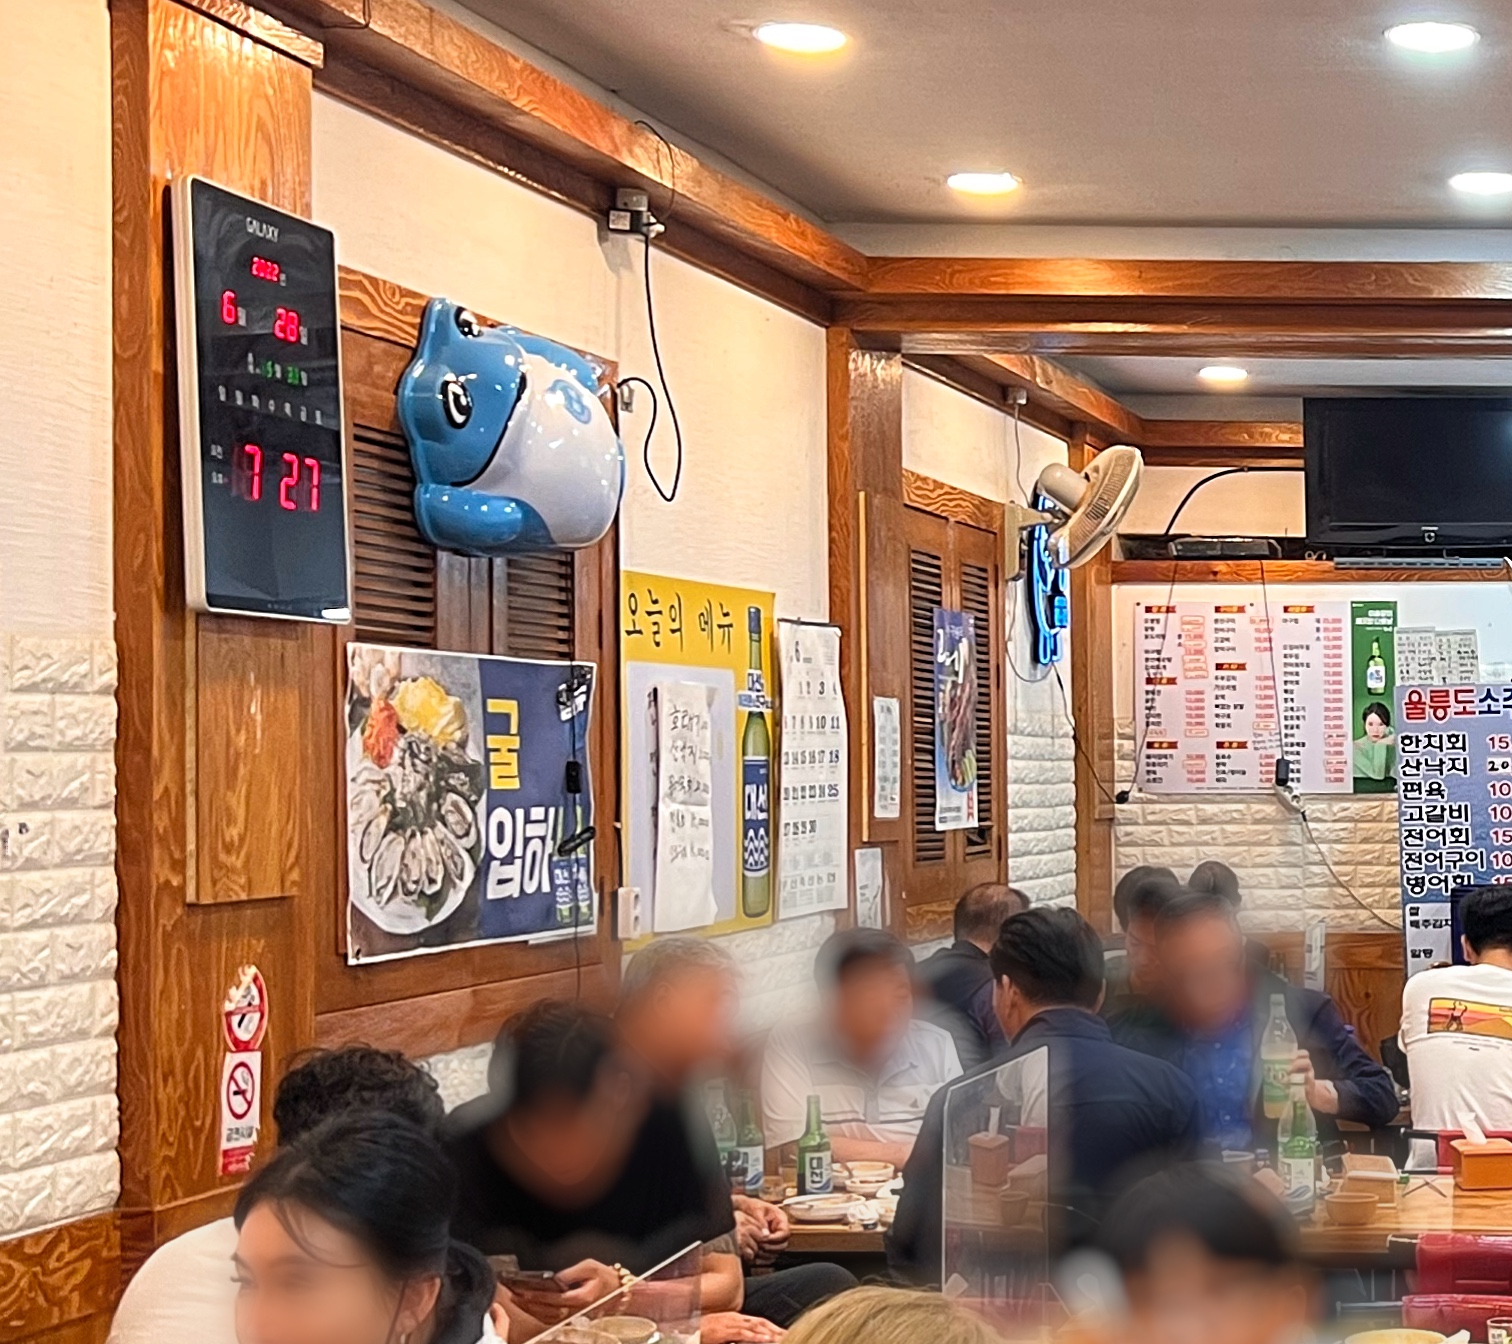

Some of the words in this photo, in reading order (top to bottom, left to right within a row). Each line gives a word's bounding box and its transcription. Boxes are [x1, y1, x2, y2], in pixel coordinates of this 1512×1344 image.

[246, 217, 279, 243] GALAXY
[251, 256, 280, 282] 2022
[221, 289, 237, 325] 6
[274, 307, 300, 344] 28
[279, 452, 322, 512] 27
[625, 588, 684, 653] 오늘의
[698, 598, 734, 654] 메뉴
[816, 715, 827, 730] 10
[830, 715, 840, 730] 11
[486, 698, 521, 790] 굴
[1400, 734, 1467, 754] 한치회
[1400, 757, 1468, 776] 산낙지
[827, 783, 840, 798] 25
[1402, 781, 1446, 800] 편육
[1403, 804, 1470, 823] 고갈비
[1403, 827, 1470, 847] 전어회
[486, 806, 556, 900] 입하
[1404, 850, 1485, 871] 전어구이
